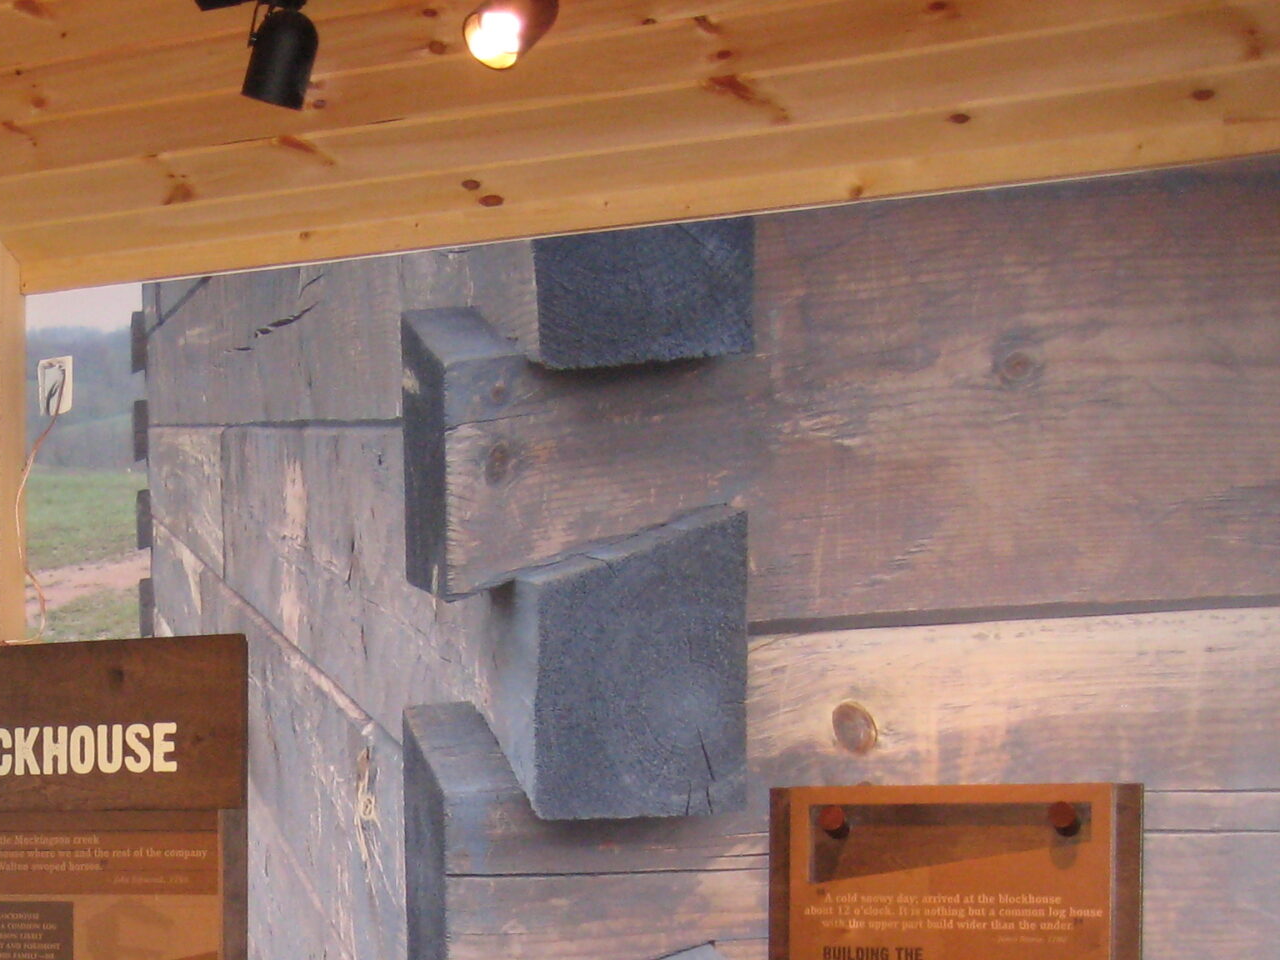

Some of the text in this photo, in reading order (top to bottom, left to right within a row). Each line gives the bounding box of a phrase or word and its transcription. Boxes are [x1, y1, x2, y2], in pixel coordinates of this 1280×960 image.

[93, 848, 110, 859] the
[112, 849, 132, 859] rest
[133, 848, 144, 859] of
[146, 848, 162, 859] the
[164, 849, 208, 861] company
[835, 892, 858, 903] cold
[860, 895, 894, 906] snowy
[922, 893, 961, 904] arrived
[963, 895, 976, 904] at
[978, 893, 996, 905] the
[999, 893, 1063, 905] blockhouse
[804, 905, 834, 916] about
[838, 906, 851, 916] 12
[923, 906, 966, 919] nothing
[968, 906, 987, 917] but
[989, 908, 996, 917] a
[999, 908, 1046, 918] common
[1049, 907, 1067, 919] log
[1069, 907, 1104, 918] house
[848, 918, 866, 929] the
[956, 919, 988, 930] wider
[990, 919, 1016, 931] than
[1018, 919, 1037, 931] the
